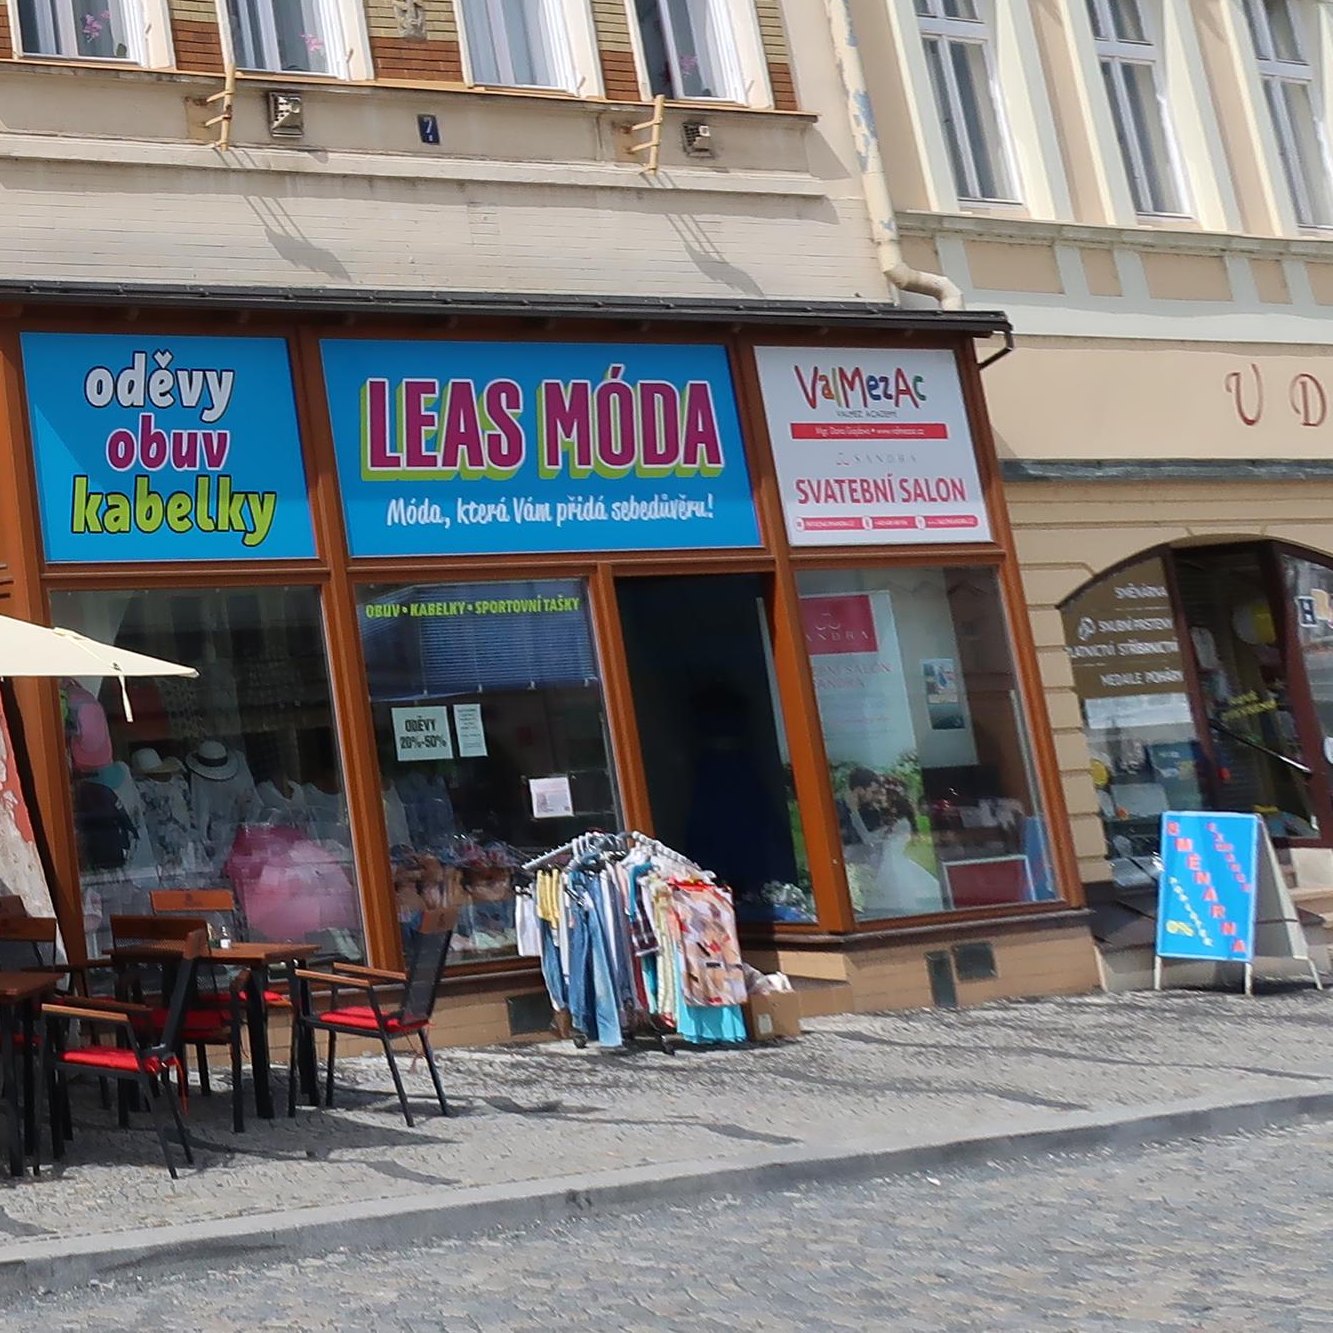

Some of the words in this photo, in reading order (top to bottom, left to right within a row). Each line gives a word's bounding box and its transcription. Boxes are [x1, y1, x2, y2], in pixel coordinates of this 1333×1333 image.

[85, 349, 235, 423] oděvy
[794, 365, 927, 409] ValMezAc
[106, 412, 230, 472] obuv
[361, 378, 526, 481] LEAS
[538, 363, 724, 478] MÓDA
[71, 474, 277, 547] kabelky
[386, 498, 451, 528] Móda,
[457, 497, 511, 524] která
[513, 496, 552, 523] Vám
[556, 494, 608, 528] přidá
[611, 492, 714, 522] sebedůvěru!
[795, 473, 895, 504] SVATEBNÍ
[900, 478, 967, 504] SALON
[365, 604, 400, 619] OBUV
[410, 601, 467, 617] KABELKY
[474, 594, 542, 614] SPORTOVNÍ
[544, 595, 581, 612] TAŠKY
[405, 715, 438, 732] ODĚVY
